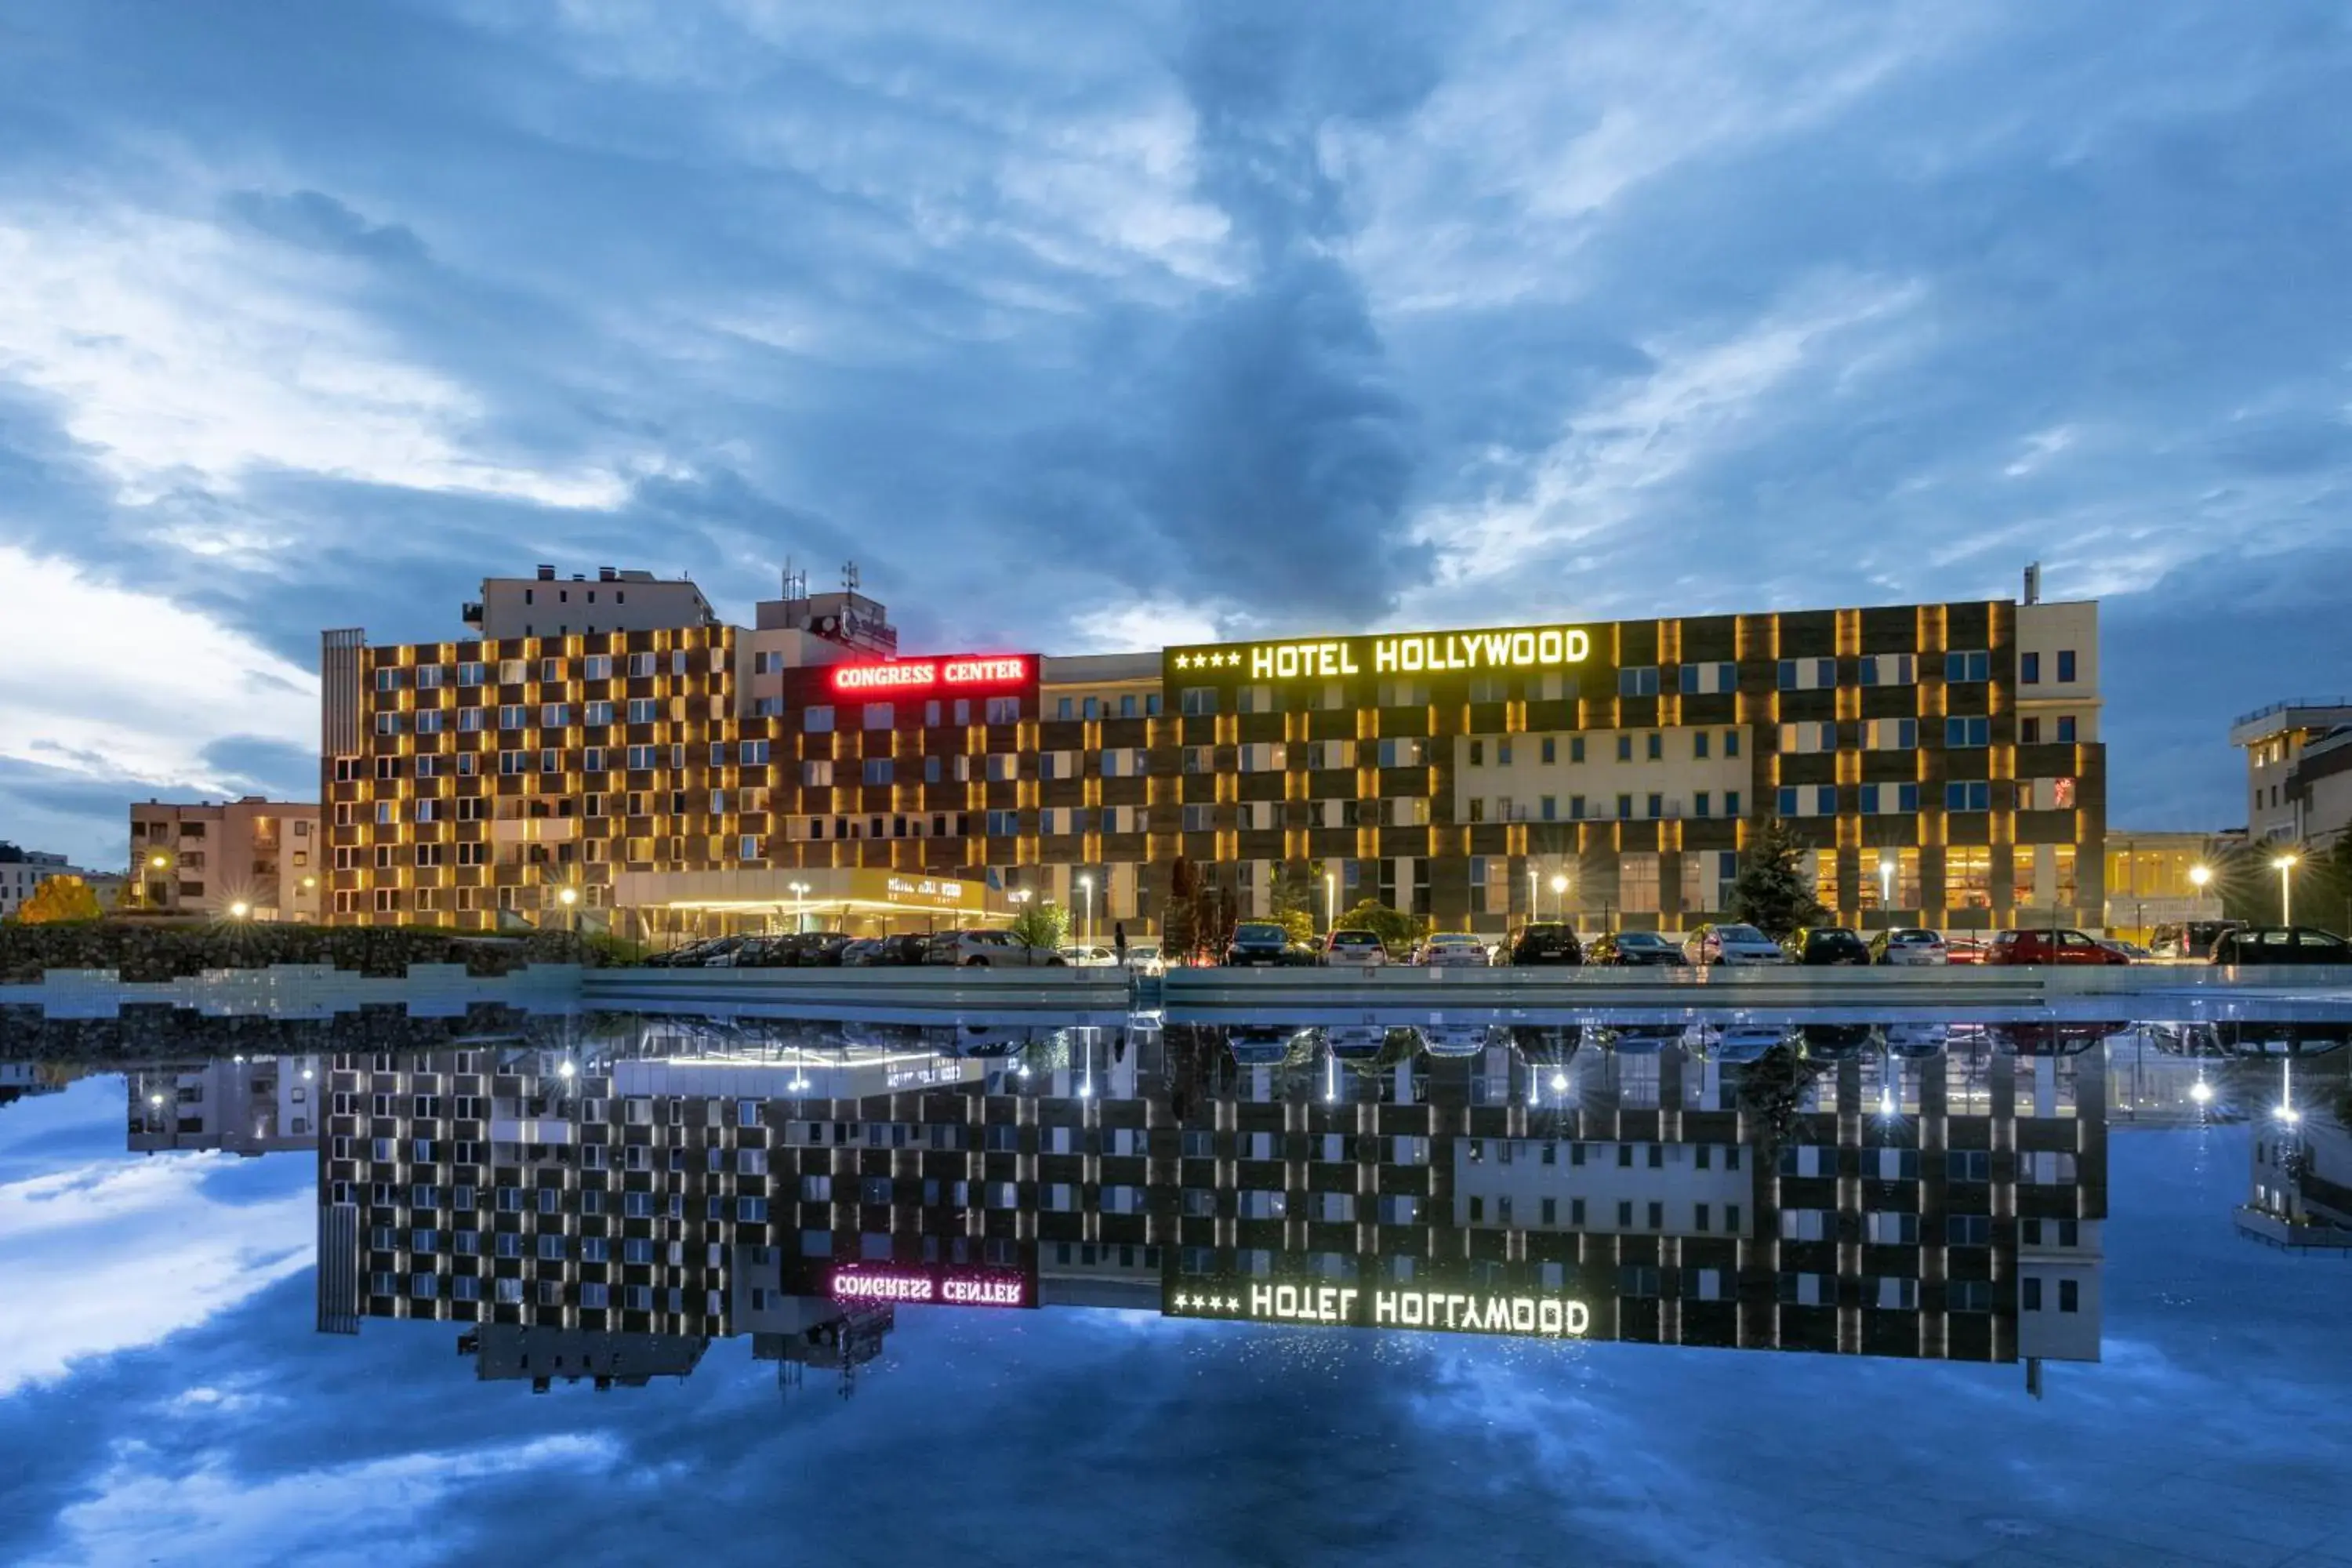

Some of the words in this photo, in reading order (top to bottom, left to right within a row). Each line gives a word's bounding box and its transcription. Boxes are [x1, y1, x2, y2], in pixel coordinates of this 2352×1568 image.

[1252, 643, 1359, 678] HOTEL
[1376, 630, 1590, 672] HOLLYWOOD
[836, 665, 934, 688] CONGRESS
[945, 660, 1022, 682] CENTER
